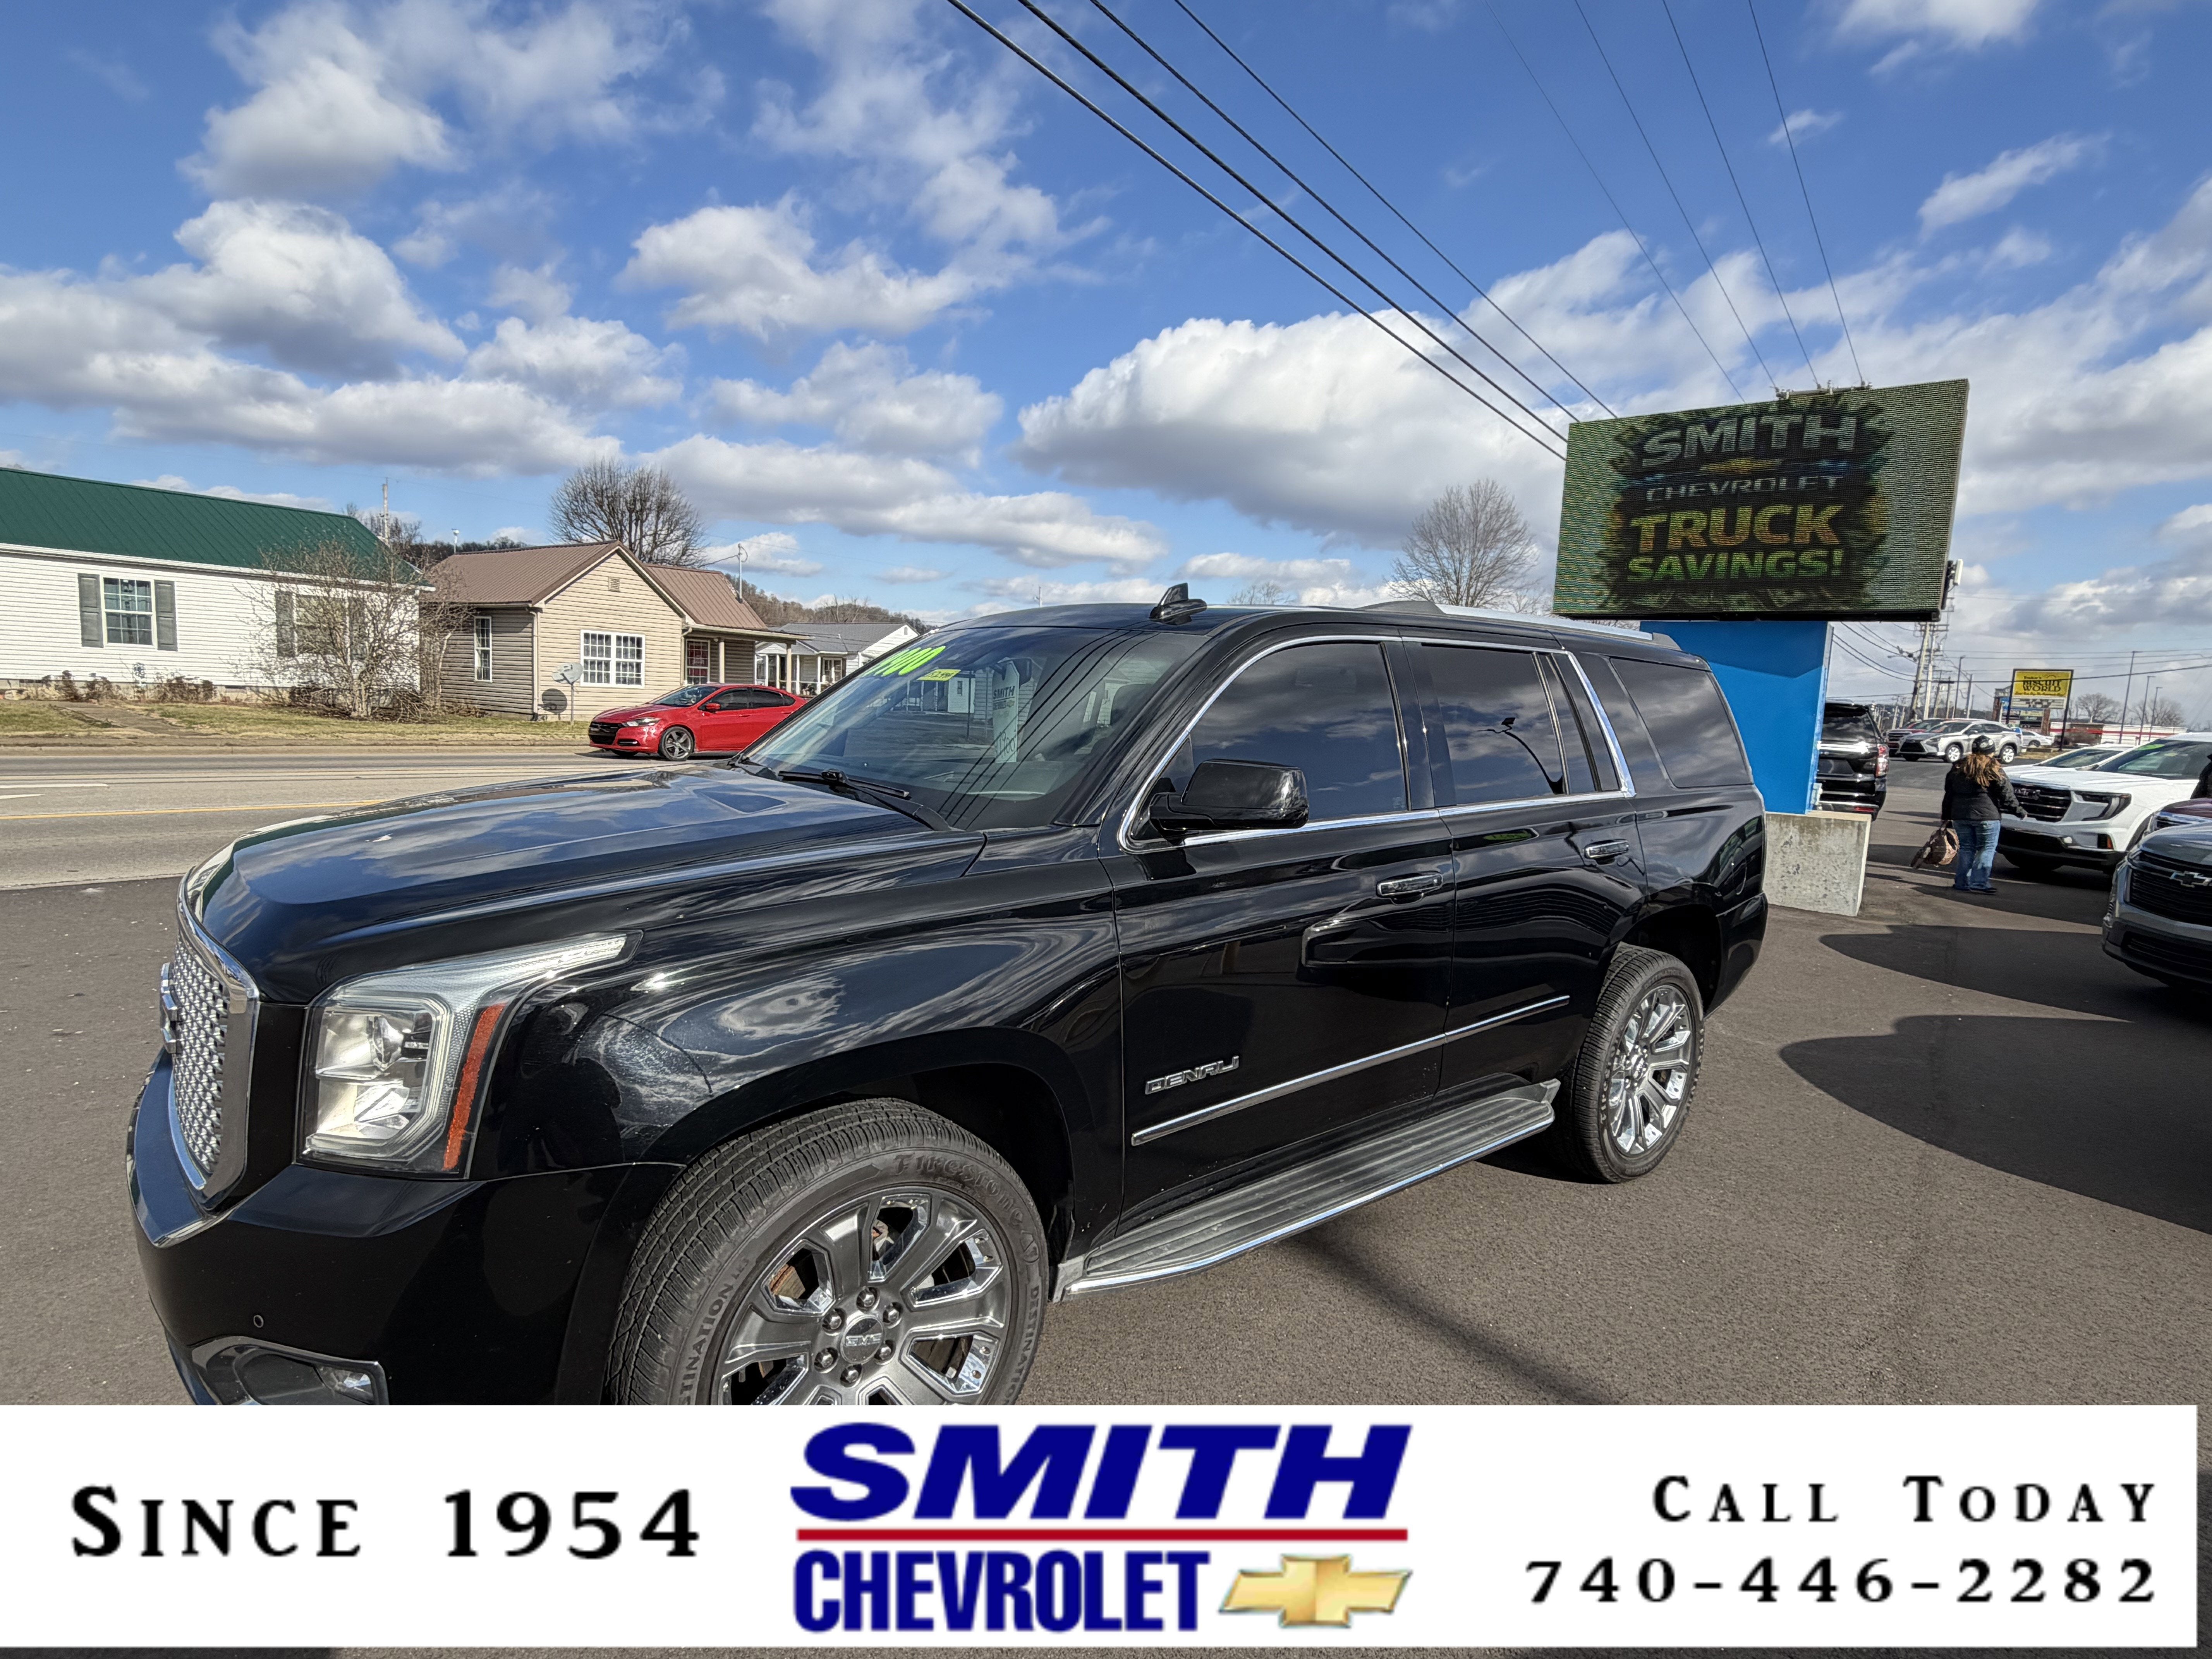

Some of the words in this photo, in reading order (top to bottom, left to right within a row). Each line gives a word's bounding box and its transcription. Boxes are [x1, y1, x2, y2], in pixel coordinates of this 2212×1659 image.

[1642, 414, 1858, 466] SMITH
[1646, 476, 1843, 501] CHEVROLET
[1630, 505, 1844, 553] TRUCK
[1627, 548, 1844, 580] SAVINGS!
[993, 685, 1015, 699] SMITH
[1145, 1056, 1239, 1095] DENALI
[893, 1152, 1023, 1226] Firestone
